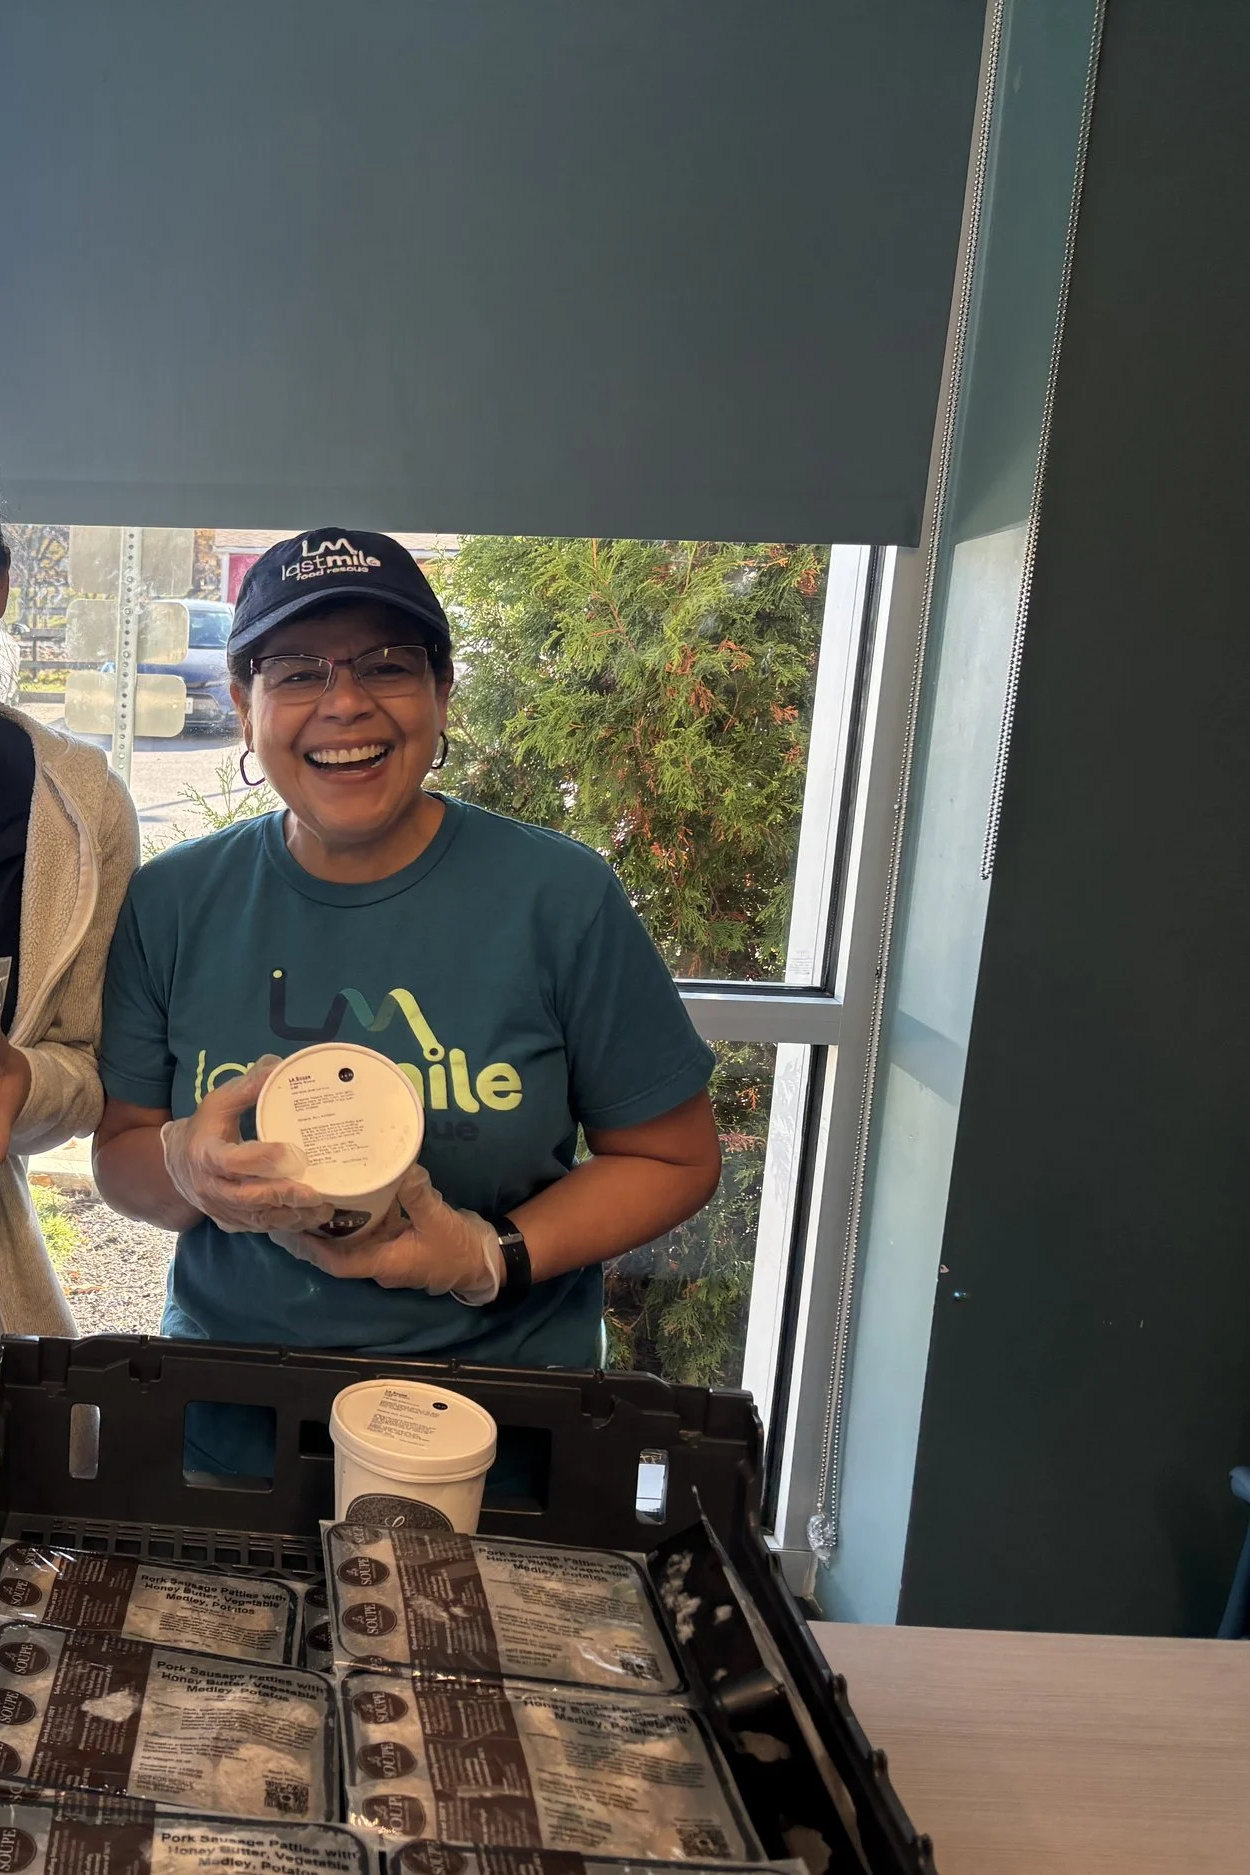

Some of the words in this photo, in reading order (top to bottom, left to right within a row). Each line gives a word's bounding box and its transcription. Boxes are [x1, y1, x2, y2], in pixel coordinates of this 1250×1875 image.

[281, 550, 381, 581] lastmile
[296, 568, 324, 581] food
[357, 1557, 373, 1586] SOUPE
[513, 1563, 560, 1577] Medley,
[607, 1562, 632, 1572] with
[11, 1580, 30, 1607] SOUPE
[141, 1574, 167, 1585] Pork
[170, 1577, 218, 1593] Sausage
[220, 1586, 259, 1600] Patties
[262, 1592, 287, 1602] with
[144, 1582, 180, 1595] Honey
[224, 1596, 280, 1609] Vegetable
[166, 1592, 209, 1607] Medley,
[364, 1603, 379, 1635] SOUPE
[14, 1643, 34, 1675] SOUPE
[157, 1660, 186, 1674] Pork
[190, 1665, 245, 1682] Sausage
[297, 1682, 324, 1694] with
[161, 1671, 202, 1686] Honey
[372, 1691, 390, 1724] SOUPE
[523, 1699, 566, 1713] Honey
[554, 1712, 607, 1729] Medley,
[161, 1832, 196, 1843] Pork
[269, 1838, 320, 1856] Patties
[168, 1844, 216, 1857] Honey
[275, 1851, 350, 1873] Vegetable
